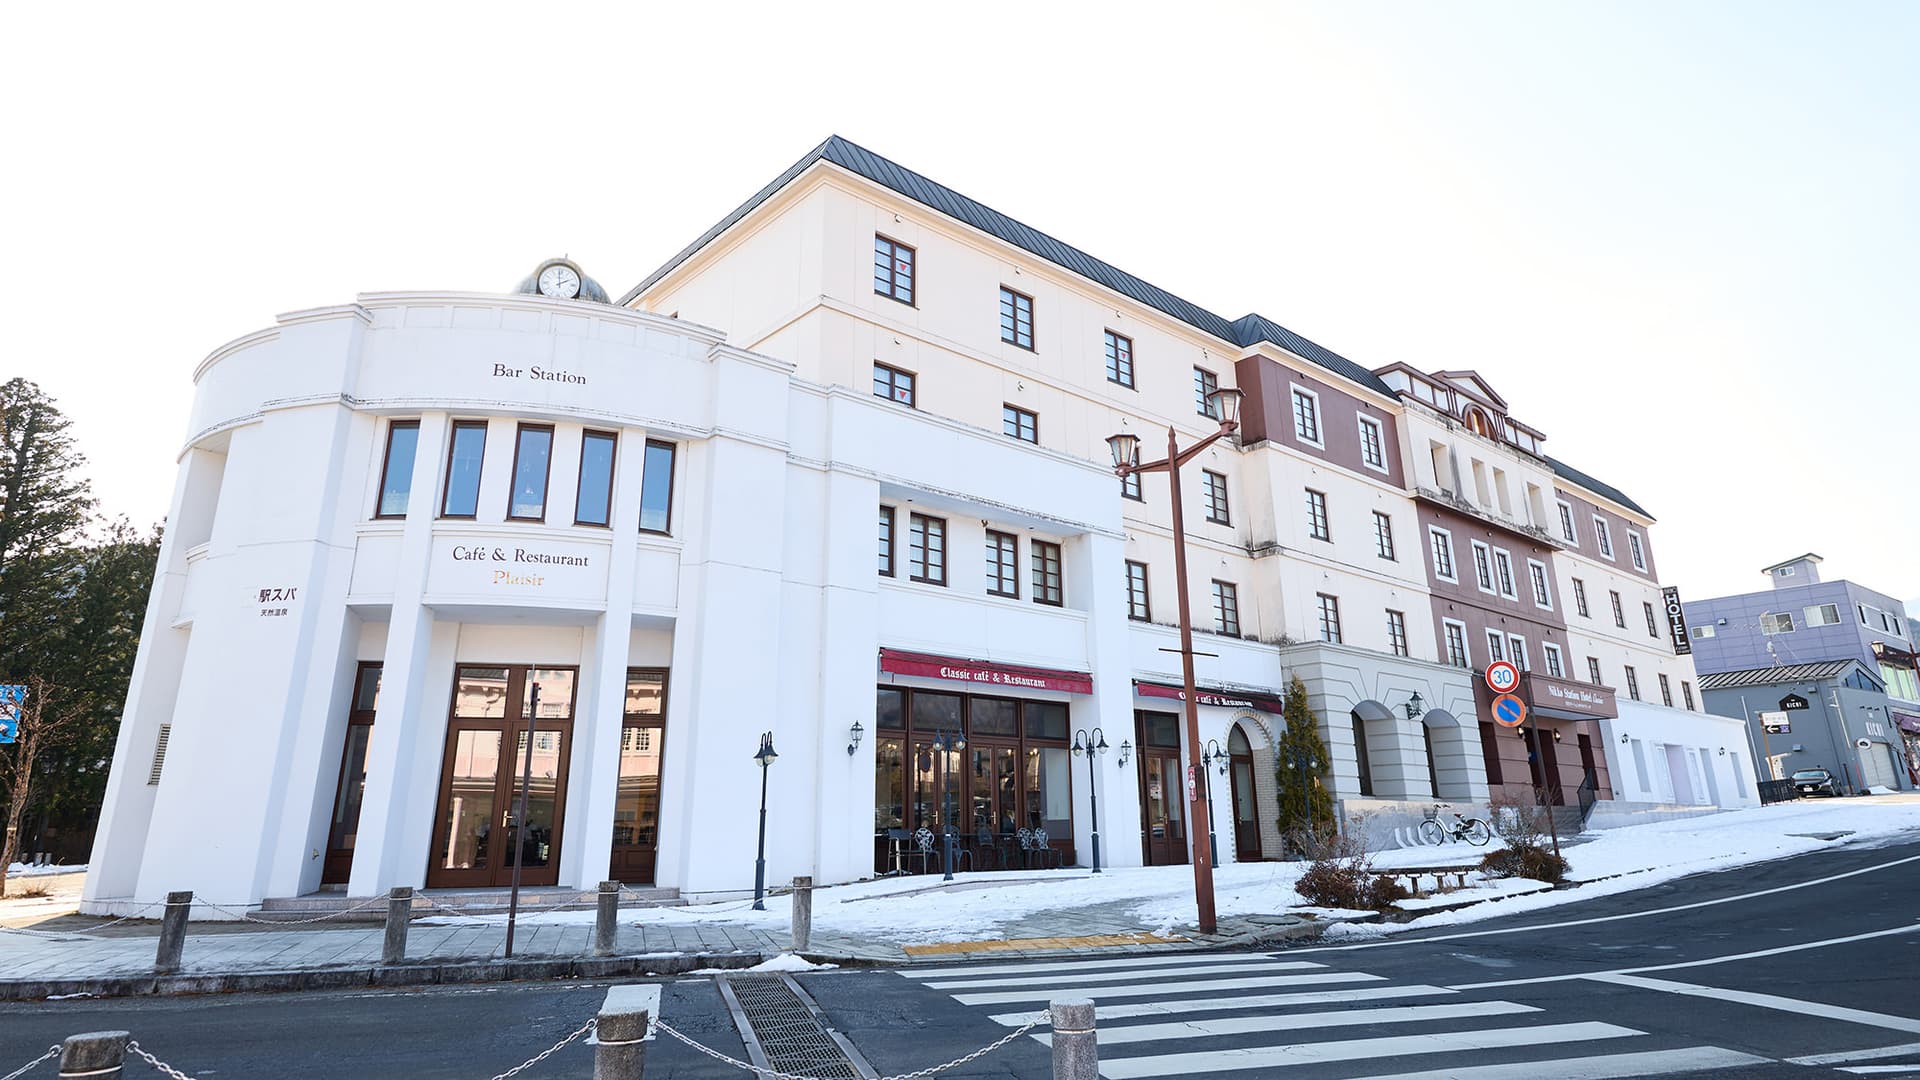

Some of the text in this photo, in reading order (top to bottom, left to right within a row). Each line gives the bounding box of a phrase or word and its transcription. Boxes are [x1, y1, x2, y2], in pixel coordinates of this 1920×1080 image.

[493, 363, 586, 385] Bar Station
[452, 545, 589, 567] Café & Restaurant
[493, 570, 545, 586] Plaisir
[1665, 594, 1687, 646] HOTEL
[940, 666, 971, 681] Classic
[992, 672, 1001, 684] &
[1003, 673, 1046, 689] Restaurant
[1493, 669, 1512, 685] 30
